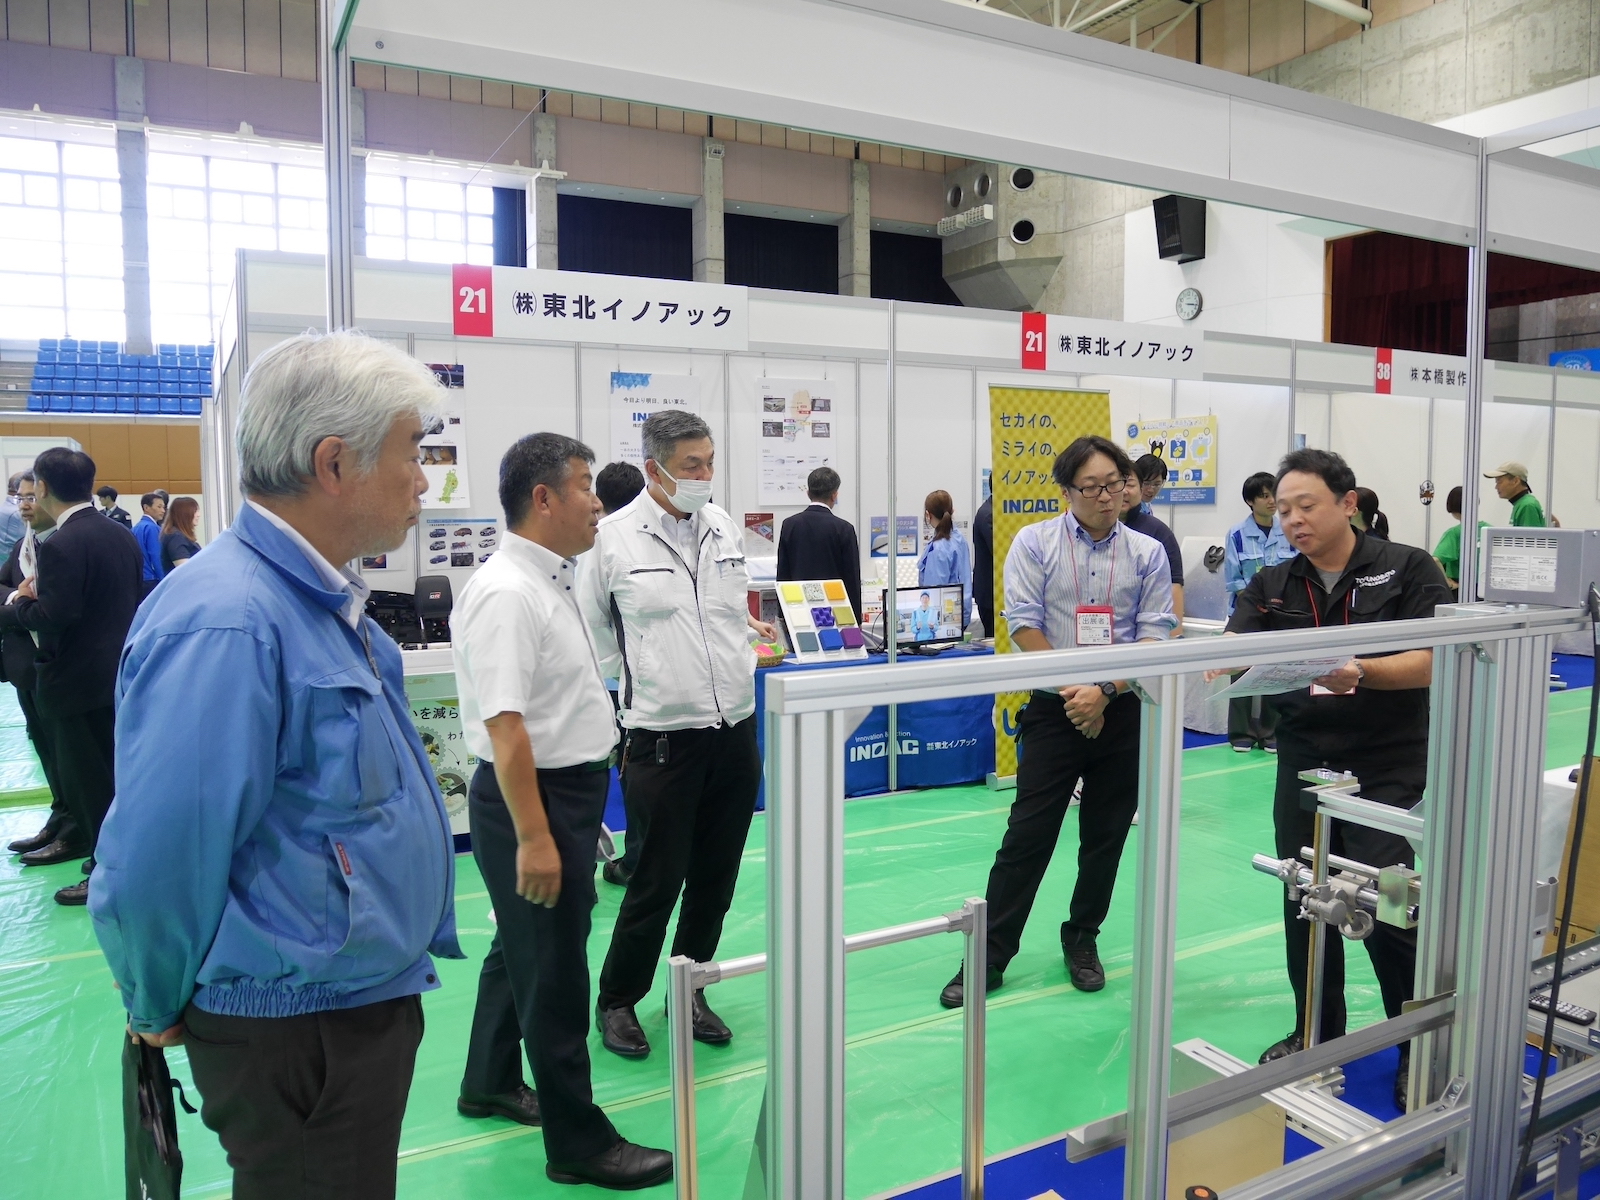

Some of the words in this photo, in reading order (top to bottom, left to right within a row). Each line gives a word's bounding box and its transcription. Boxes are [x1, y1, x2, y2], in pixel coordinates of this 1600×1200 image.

[459, 286, 486, 313] 21
[1025, 330, 1043, 352] 21
[1376, 363, 1391, 380] 38
[632, 412, 653, 421] IN
[1000, 412, 1056, 429] セカイの、
[1002, 440, 1057, 457] ミライの、
[1003, 499, 1059, 514] INOAC
[855, 732, 884, 743] Innovation
